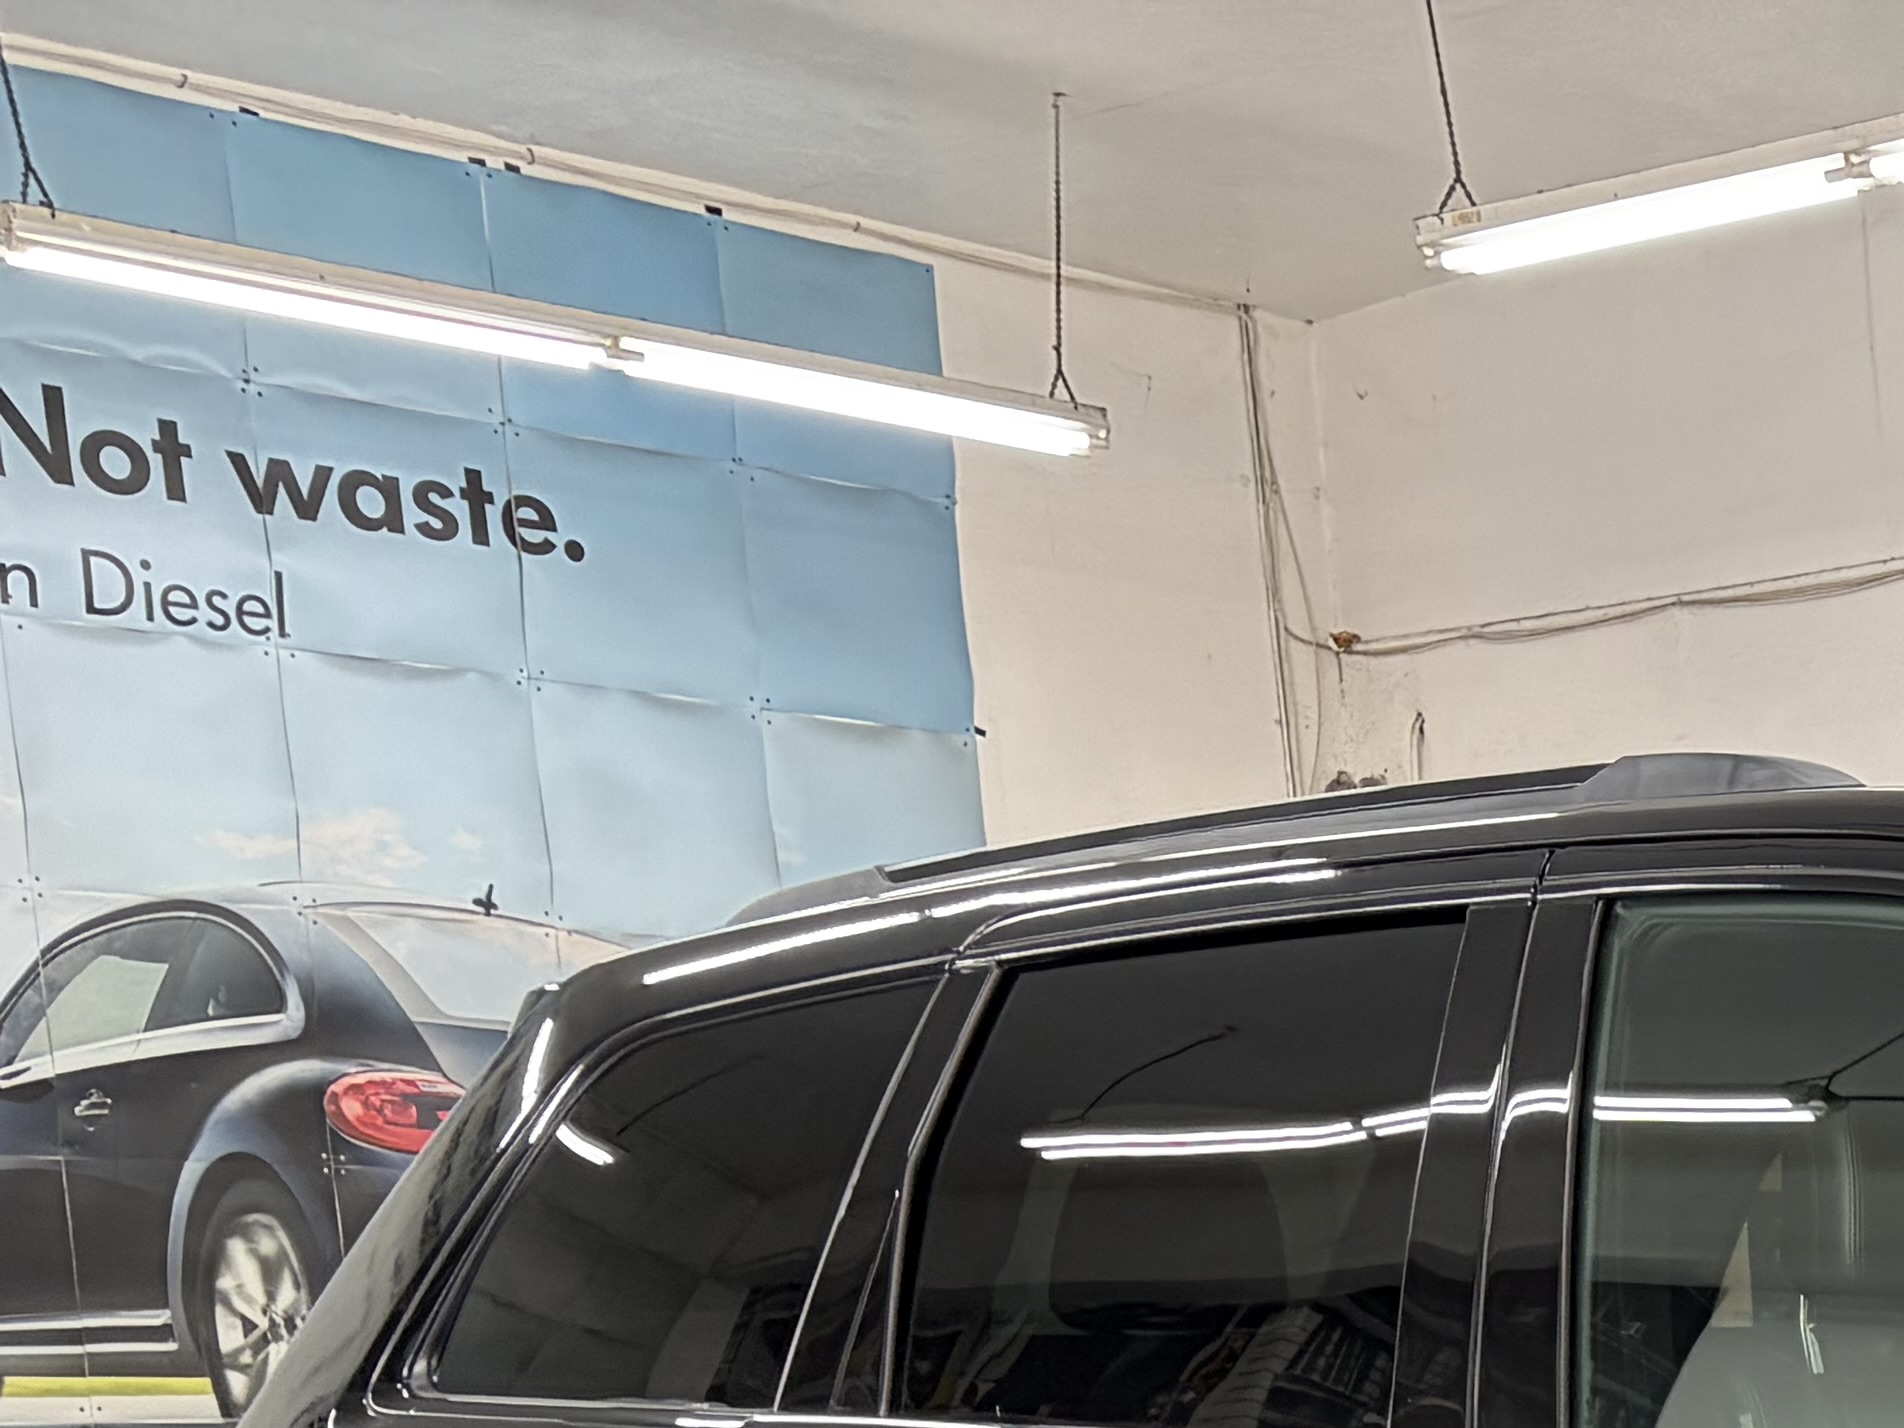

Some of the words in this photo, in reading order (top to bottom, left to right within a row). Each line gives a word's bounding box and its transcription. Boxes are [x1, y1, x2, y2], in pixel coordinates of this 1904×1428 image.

[0, 383, 193, 503] Not
[224, 447, 586, 563] waste.
[80, 547, 290, 638] Diesel
